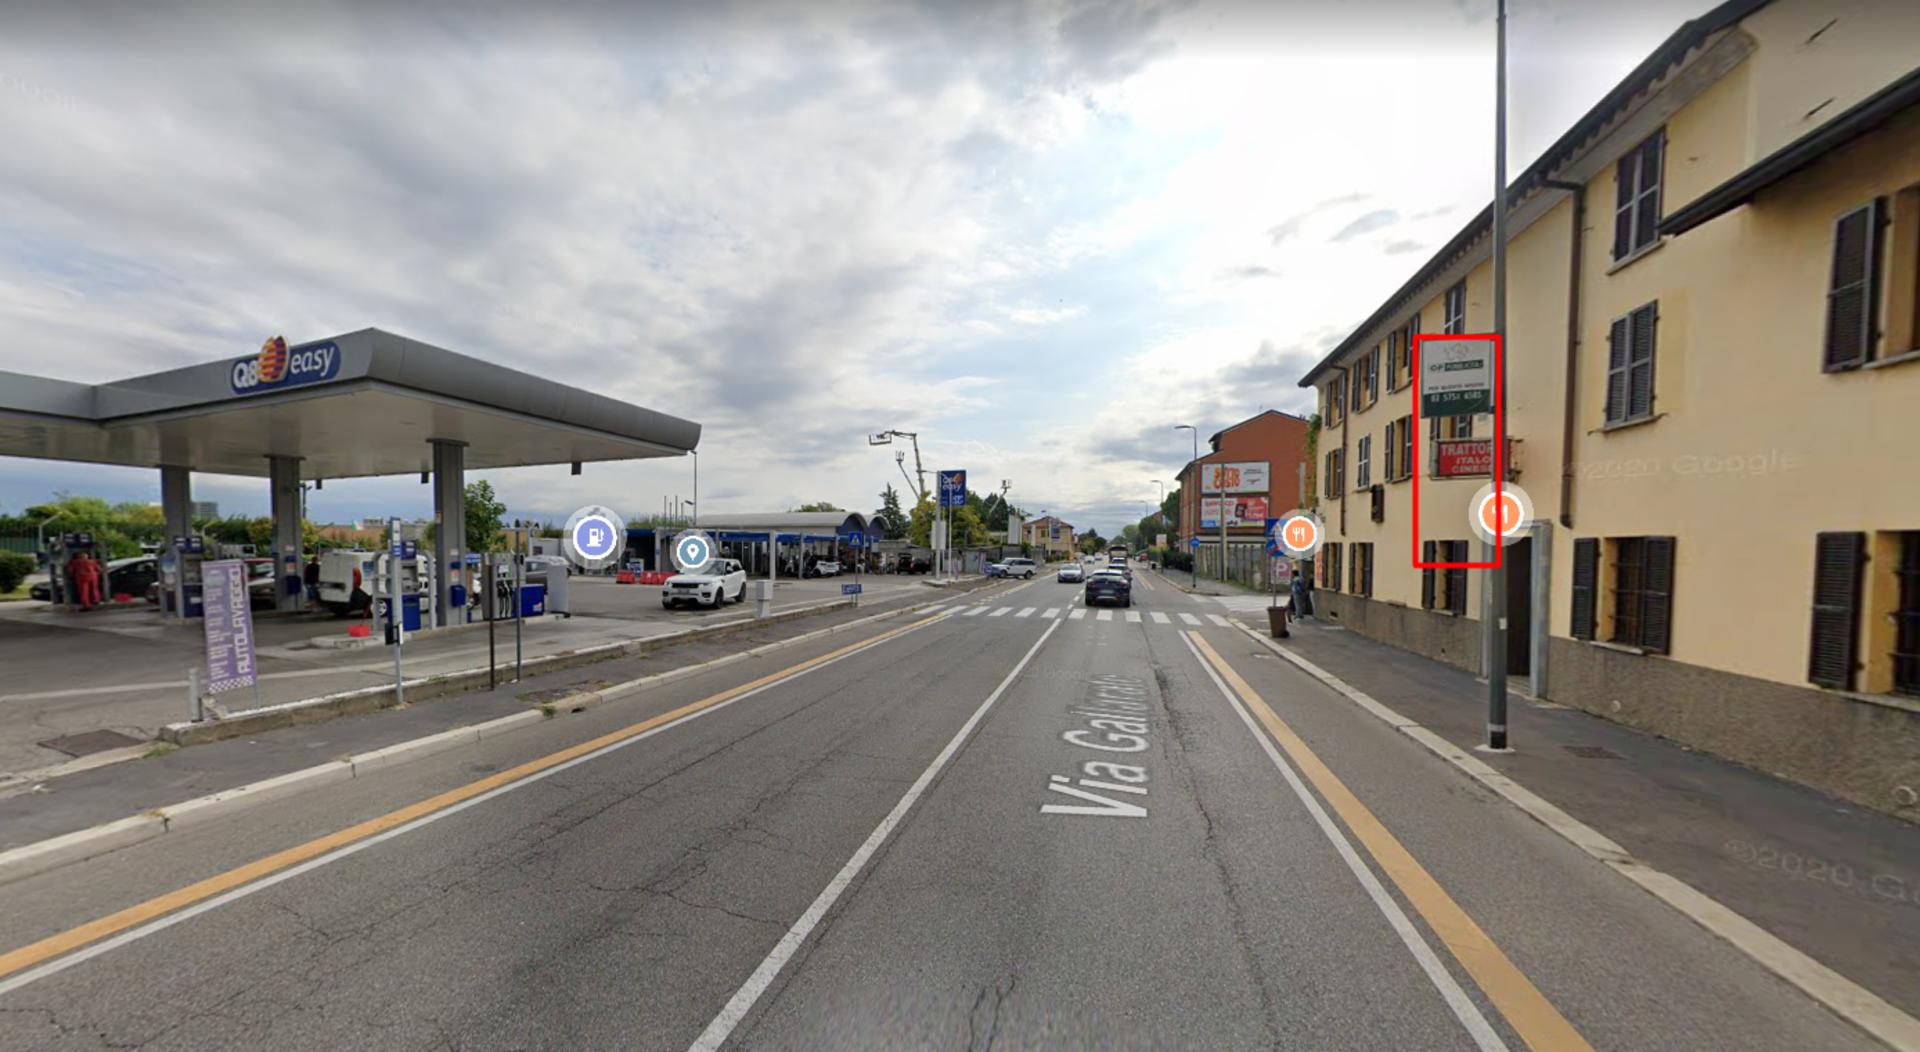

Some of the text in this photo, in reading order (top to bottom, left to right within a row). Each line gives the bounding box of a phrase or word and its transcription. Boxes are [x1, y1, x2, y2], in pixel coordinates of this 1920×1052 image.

[233, 346, 335, 388] Q8 easy
[1441, 442, 1493, 456] TRATTOR
